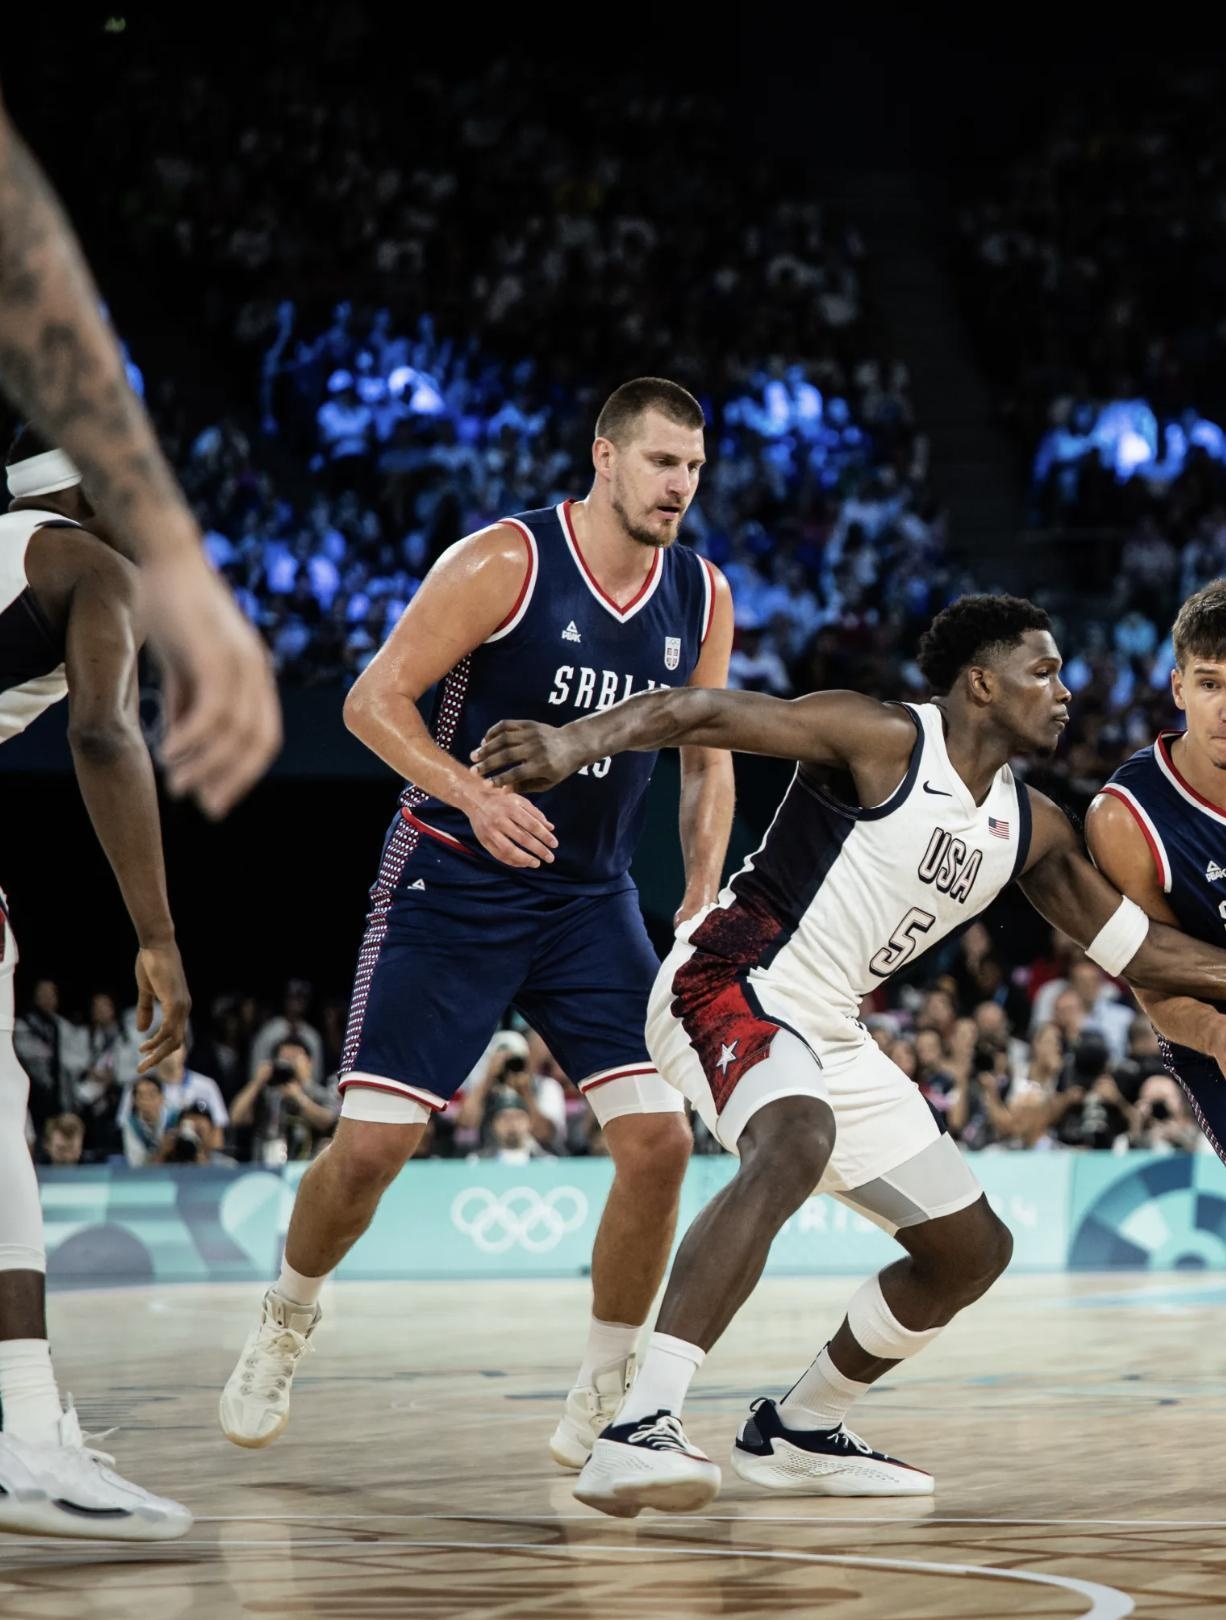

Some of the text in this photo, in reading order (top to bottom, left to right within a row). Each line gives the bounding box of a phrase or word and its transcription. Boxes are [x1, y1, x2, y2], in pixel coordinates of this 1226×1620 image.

[548, 665, 672, 710] SRBI
[918, 826, 983, 904] USA
[868, 906, 936, 978] 5
